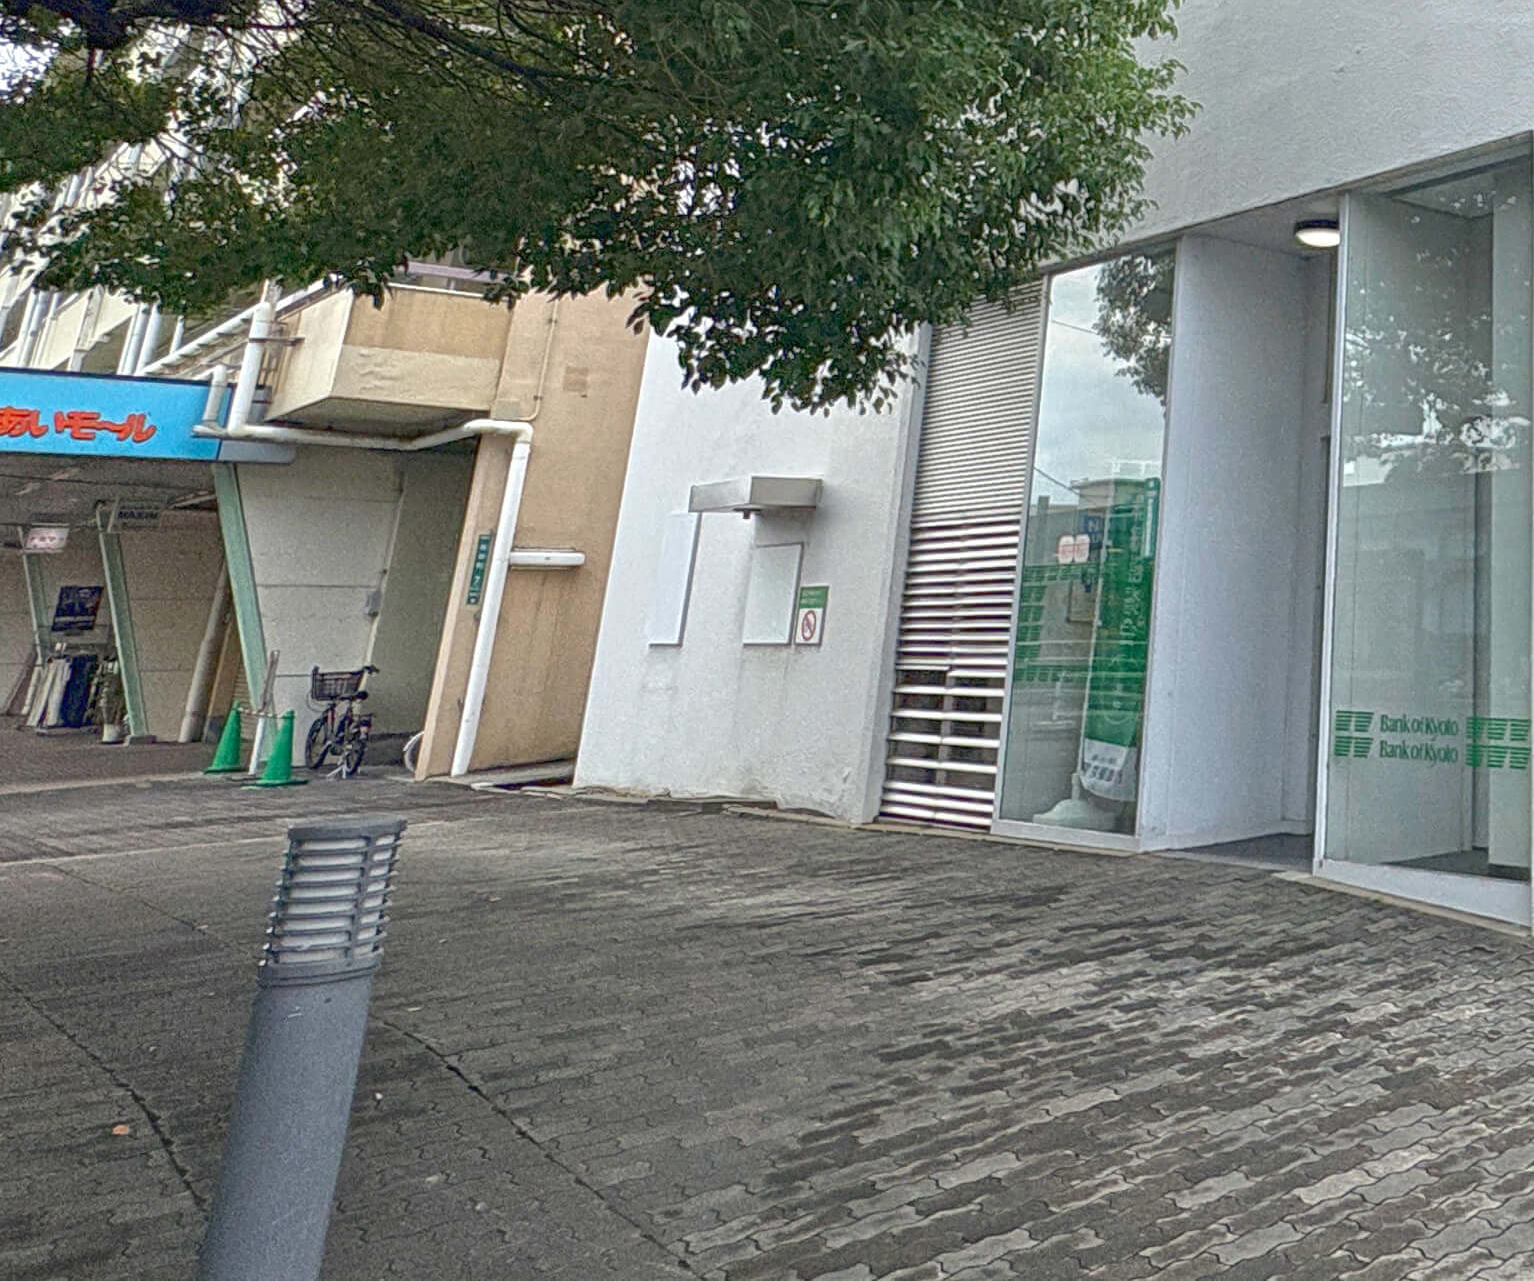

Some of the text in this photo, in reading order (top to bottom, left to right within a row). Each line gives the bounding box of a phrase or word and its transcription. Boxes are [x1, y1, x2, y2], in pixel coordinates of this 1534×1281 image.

[1380, 713, 1409, 732] Bank
[1425, 717, 1459, 741] Kyoto
[1379, 739, 1409, 759] Bank
[1424, 743, 1459, 767] Kyoto
